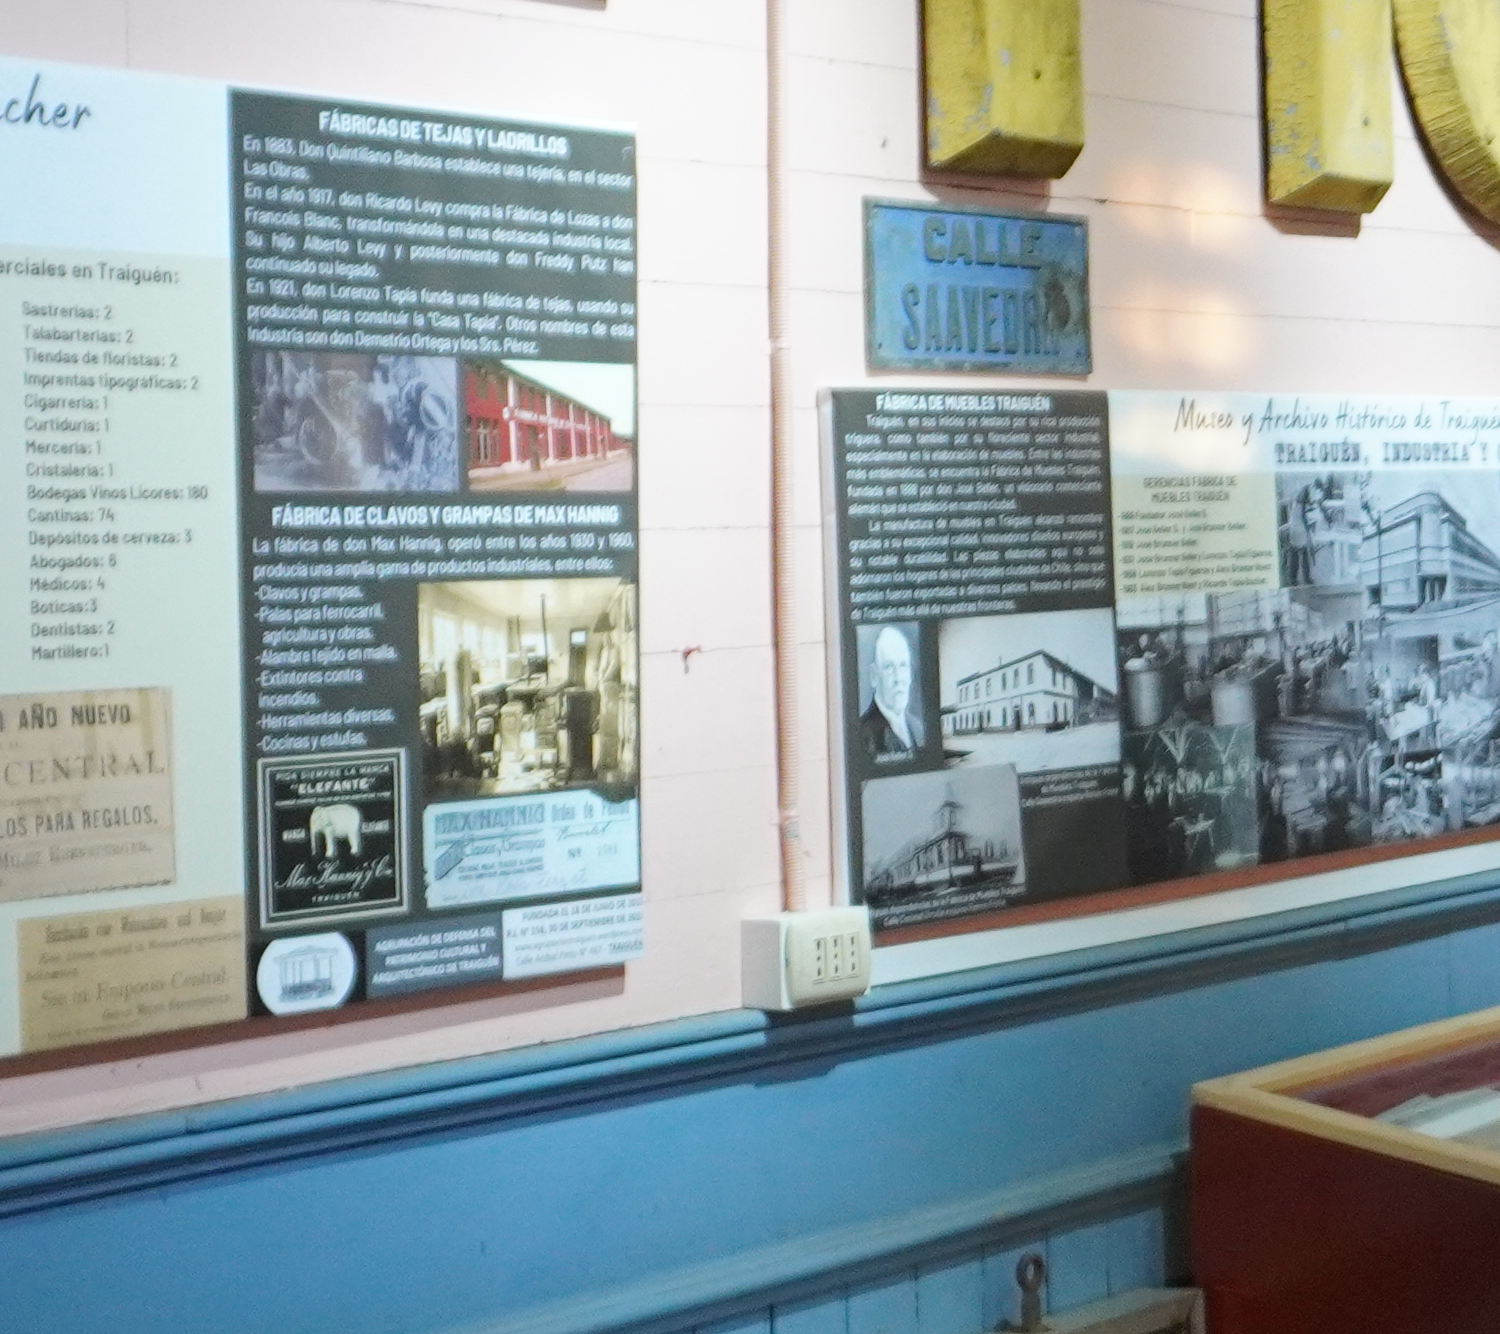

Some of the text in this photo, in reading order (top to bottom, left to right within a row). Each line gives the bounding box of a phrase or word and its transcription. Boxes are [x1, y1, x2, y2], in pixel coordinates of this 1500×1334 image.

[318, 108, 569, 156] FÁBRICAS DE TEJAS Y LADRILLOS
[922, 215, 1042, 271] CALLE
[71, 264, 93, 279] en
[99, 261, 180, 286] Traiguén:
[875, 391, 1051, 412] FÁBRICA DE MUEBLES TRAIGUÉN
[1173, 396, 1235, 432] Museo
[1241, 412, 1254, 446] y
[1257, 397, 1329, 434] Archivo
[1335, 398, 1407, 431] Histórico
[1412, 403, 1433, 430] de
[1382, 441, 1471, 462] INDUSTRIA
[1480, 442, 1490, 462] Y
[271, 502, 621, 527] FÁBRICA DE CLAVOS Y GRAMPAS DE MAX HANNIG
[252, 536, 271, 554] La
[274, 535, 320, 554] fábrica
[322, 535, 340, 553] de
[343, 535, 368, 552] don
[371, 535, 396, 552] Max
[18, 703, 58, 731] AÑO
[69, 702, 132, 729] NUEVO
[2, 749, 168, 787] CENTRAL
[34, 813, 76, 835] PARA
